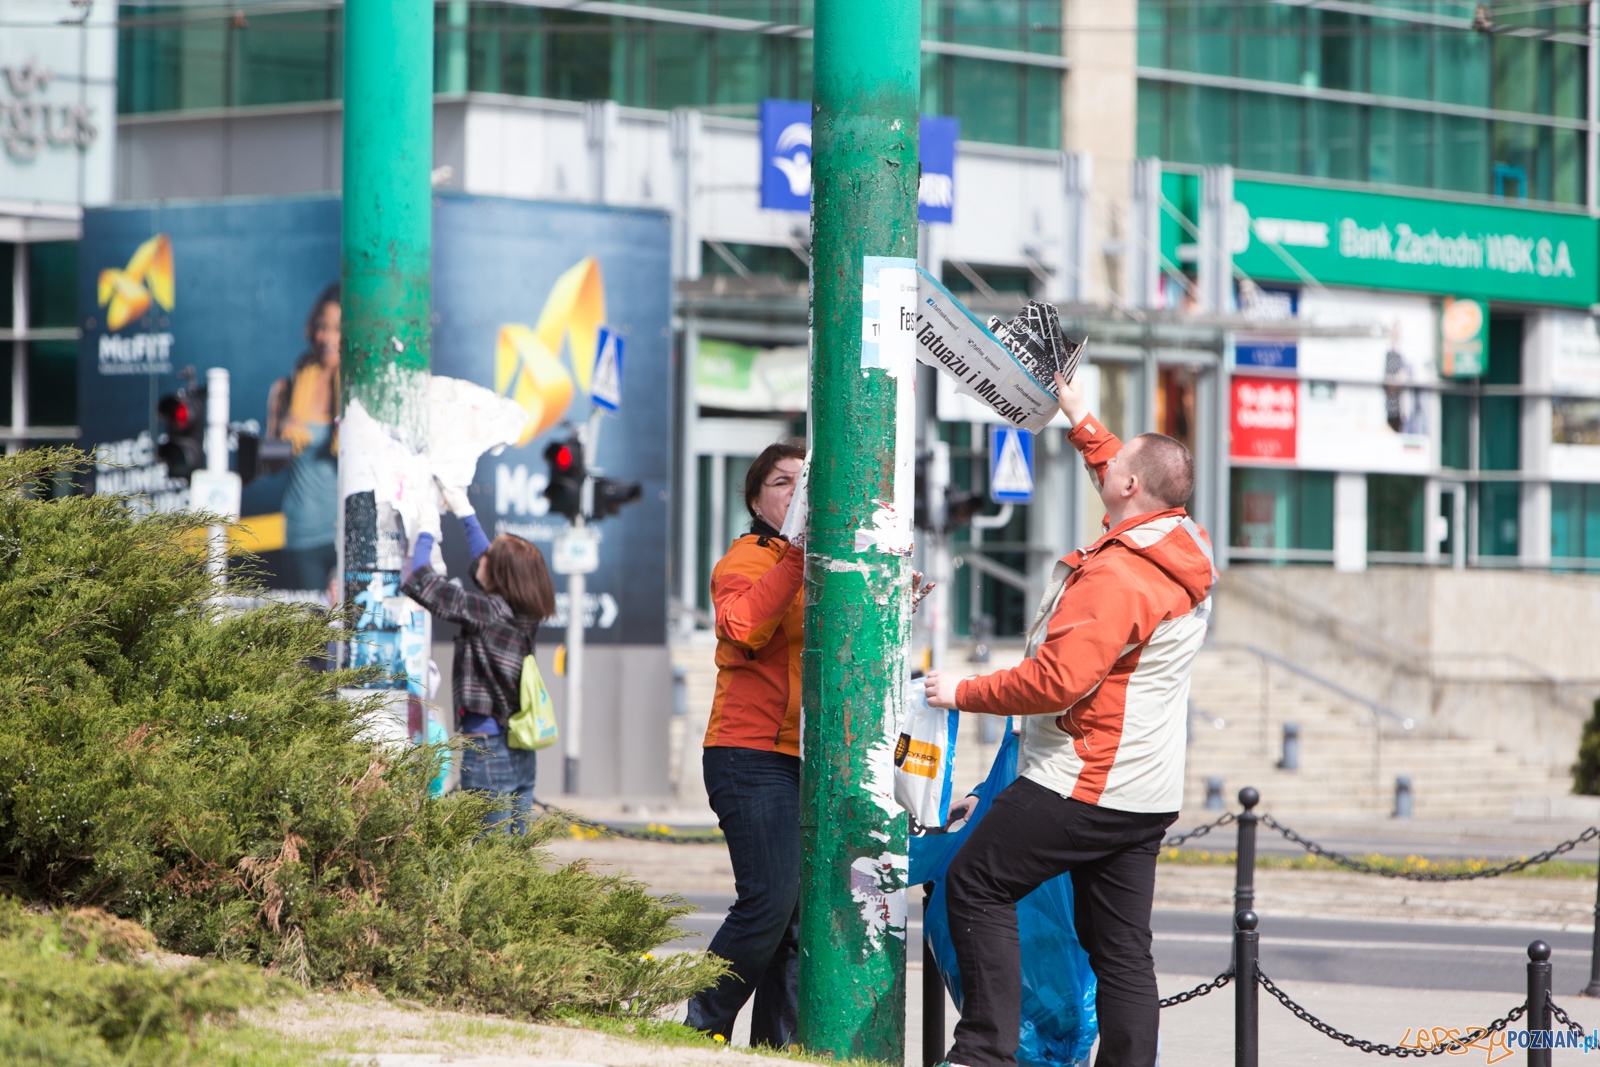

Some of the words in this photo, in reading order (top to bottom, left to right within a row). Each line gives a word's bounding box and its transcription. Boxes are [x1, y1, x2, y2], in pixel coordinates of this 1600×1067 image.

[1339, 217, 1393, 260] Bank
[99, 333, 174, 362] McFIT
[916, 321, 970, 377] Tatuażu
[966, 370, 982, 384] i
[974, 377, 1031, 424] Muzyki
